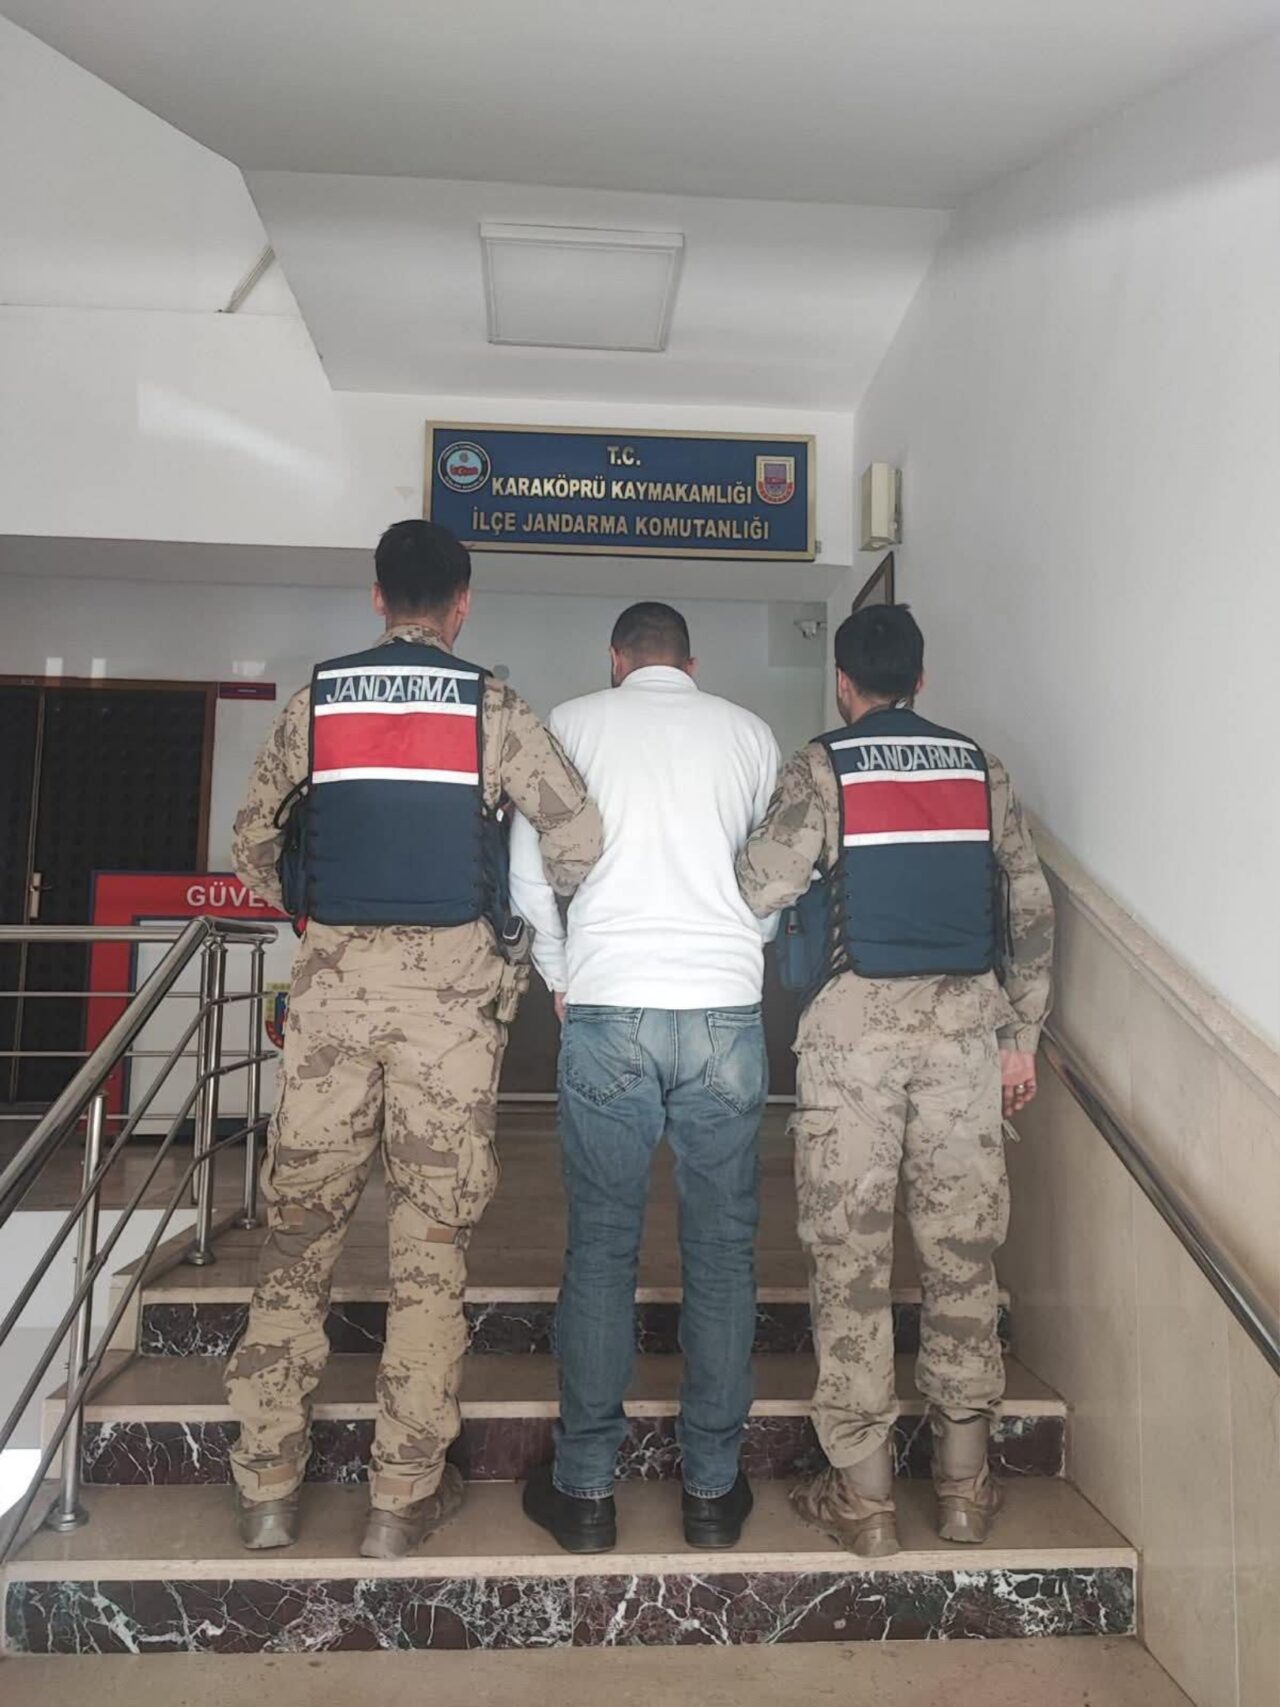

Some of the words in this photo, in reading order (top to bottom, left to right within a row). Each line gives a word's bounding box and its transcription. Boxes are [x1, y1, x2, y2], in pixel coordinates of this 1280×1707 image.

[606, 445, 641, 466] T.C.
[491, 474, 606, 499] KARAKÖPRÜ
[611, 480, 752, 505] KAYMAKAMLIĞI
[472, 506, 516, 536] İLÇE
[522, 512, 628, 535] JANDARMA
[635, 516, 769, 540] KOMUTANLIĞI
[325, 674, 461, 705] JANDARMA
[857, 744, 976, 771] JANDARMA
